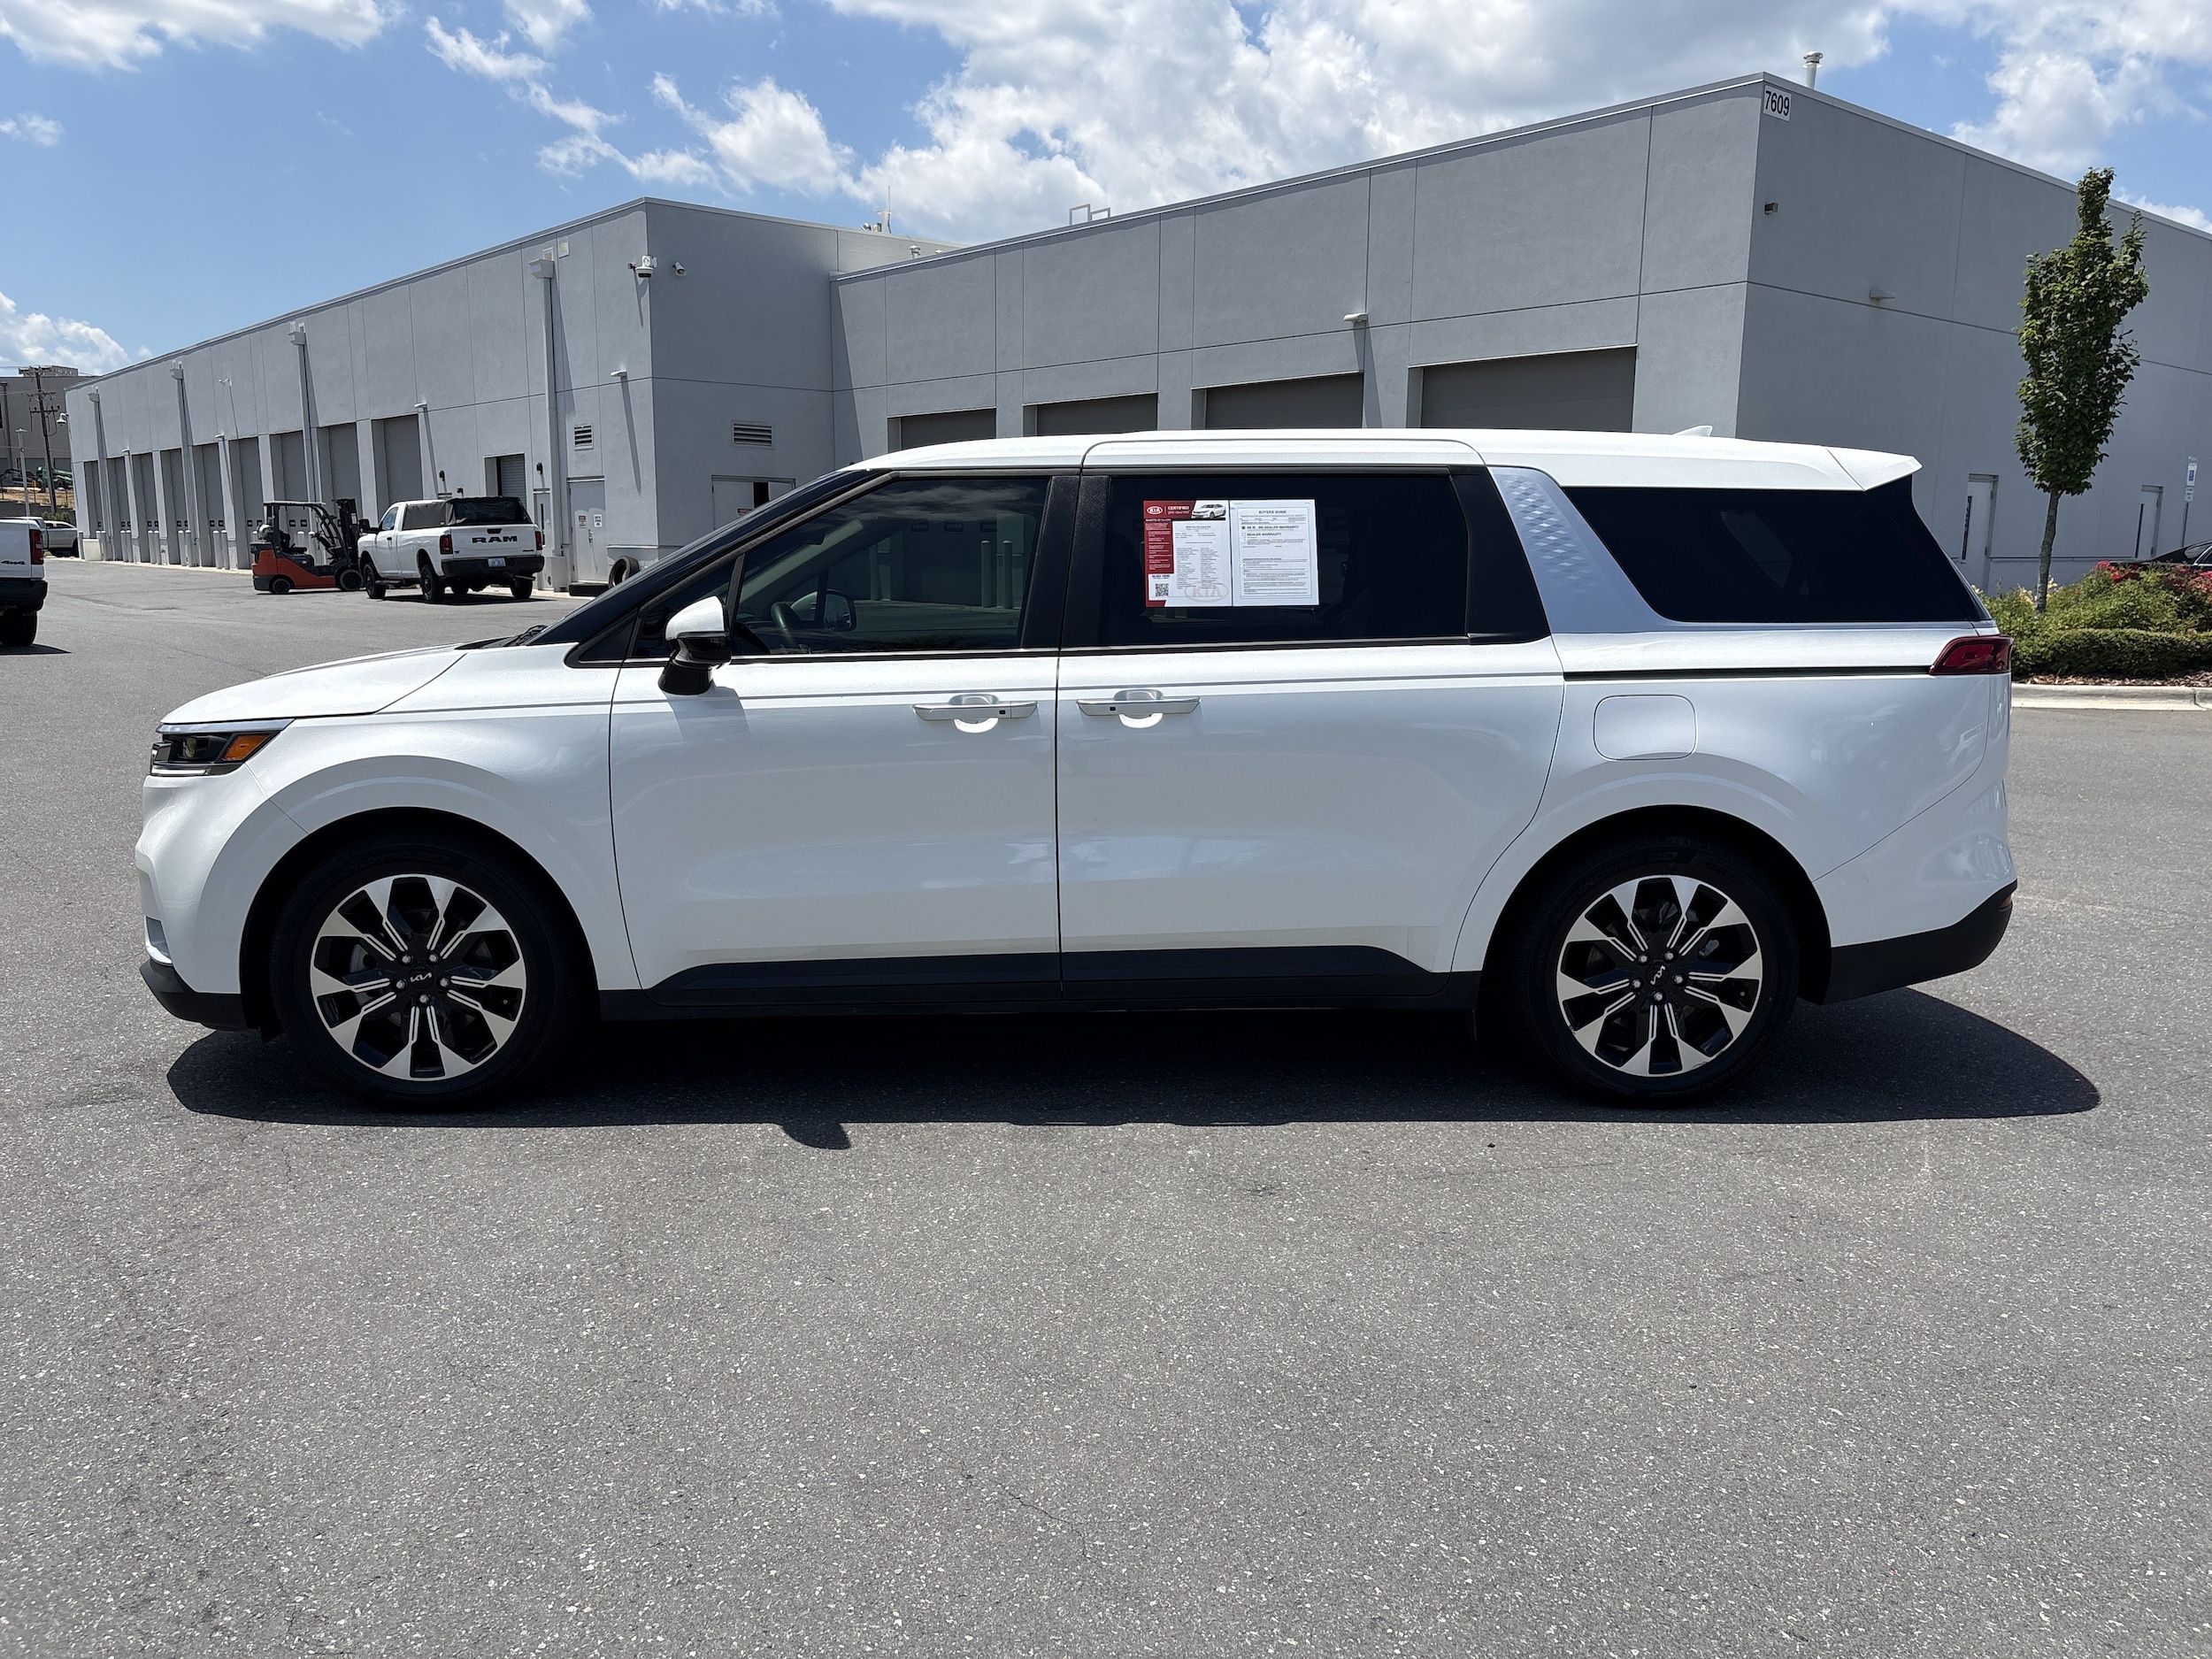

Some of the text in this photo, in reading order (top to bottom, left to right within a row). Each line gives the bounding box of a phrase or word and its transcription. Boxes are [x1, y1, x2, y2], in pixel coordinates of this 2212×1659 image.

[1765, 90, 1790, 116] 7609
[1192, 586, 1222, 597] KIA
[410, 972, 432, 983] KIA
